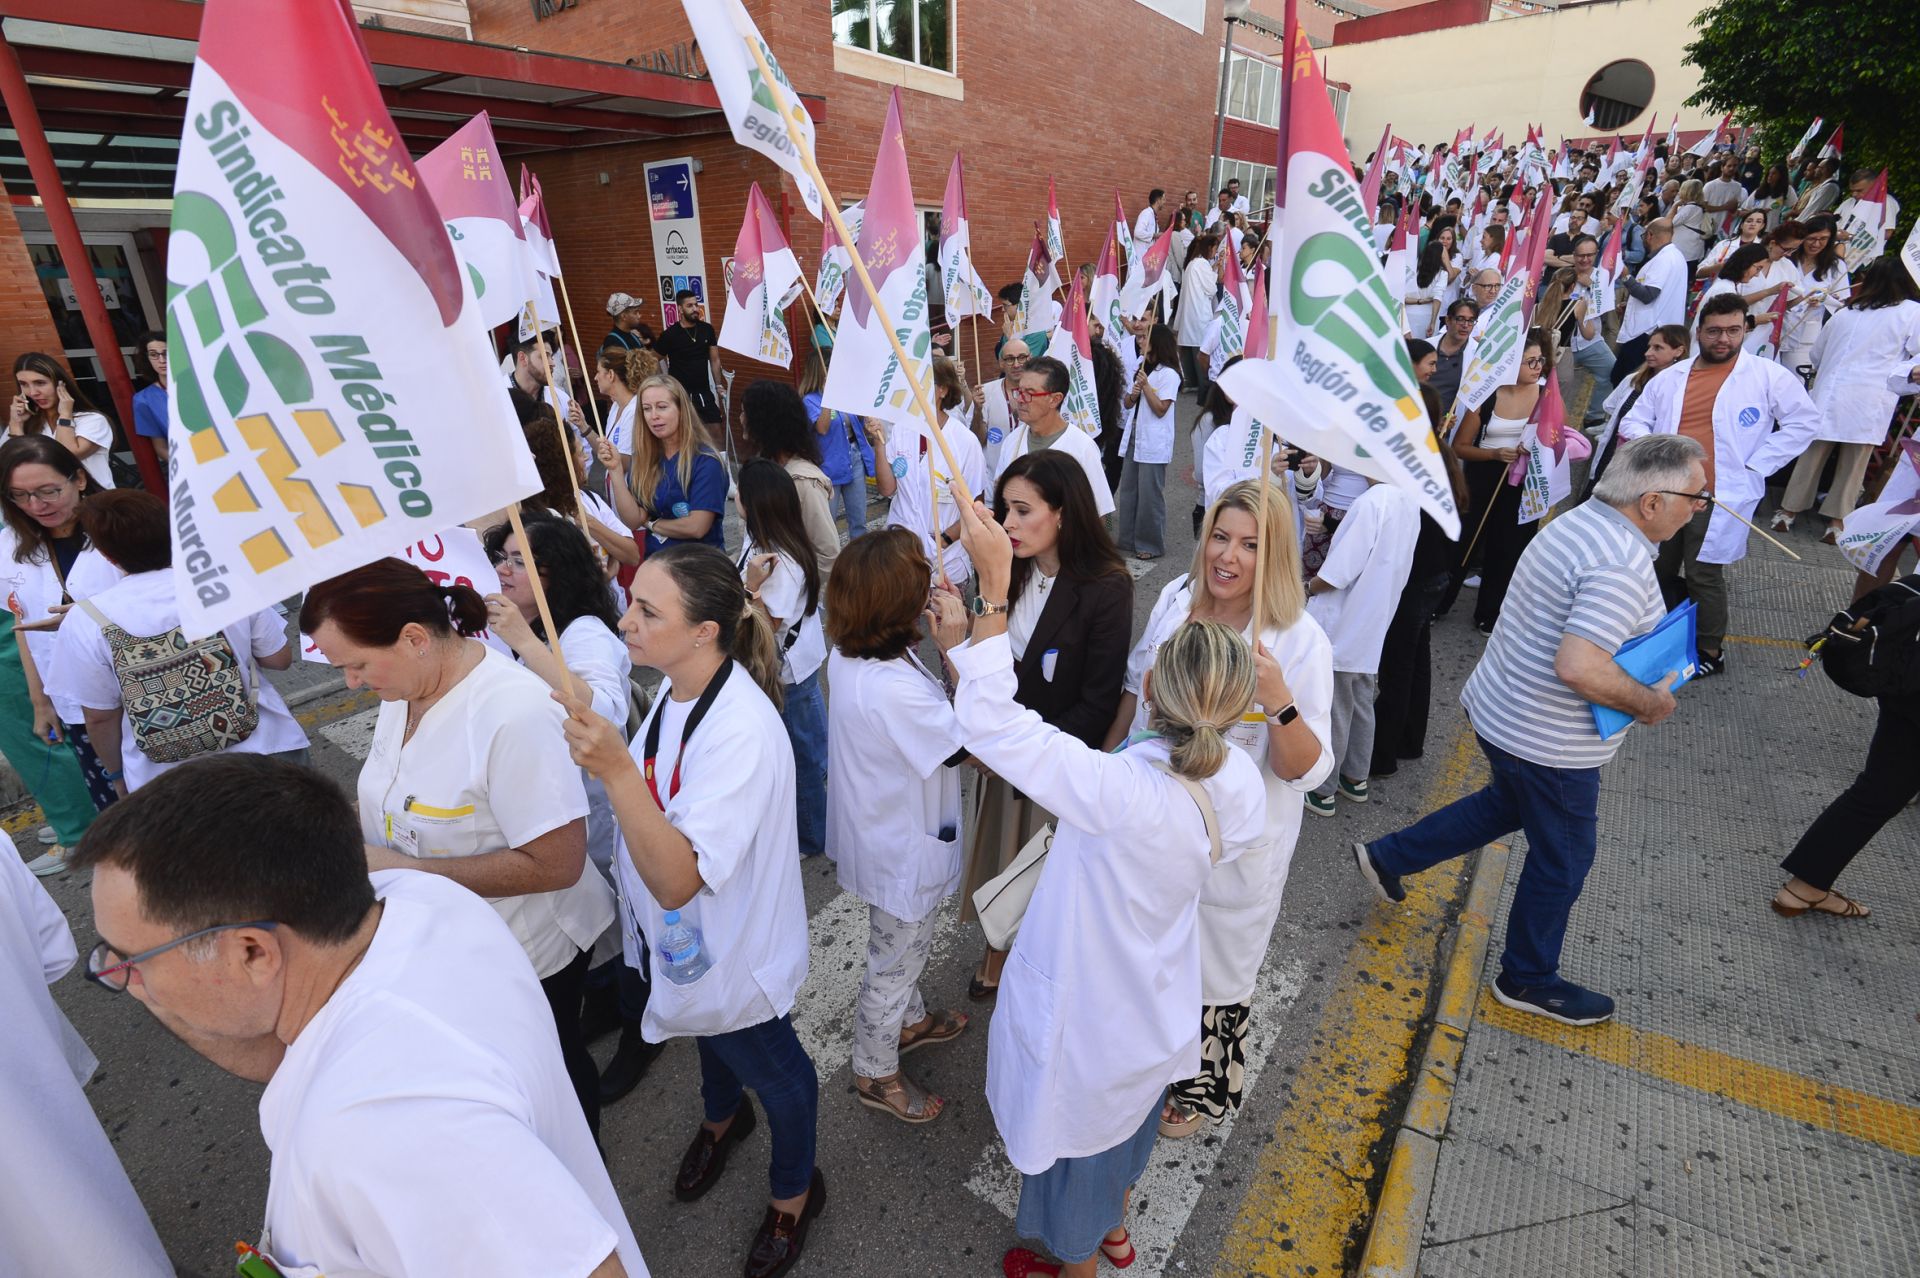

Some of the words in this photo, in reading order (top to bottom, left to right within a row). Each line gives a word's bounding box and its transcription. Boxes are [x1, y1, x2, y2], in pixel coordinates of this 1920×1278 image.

[194, 100, 336, 315] Sindicato
[309, 334, 433, 518] Médico
[1292, 340, 1359, 402] Región
[1355, 401, 1389, 433] de
[1385, 432, 1454, 514] Murcia
[172, 479, 232, 609] Murcia
